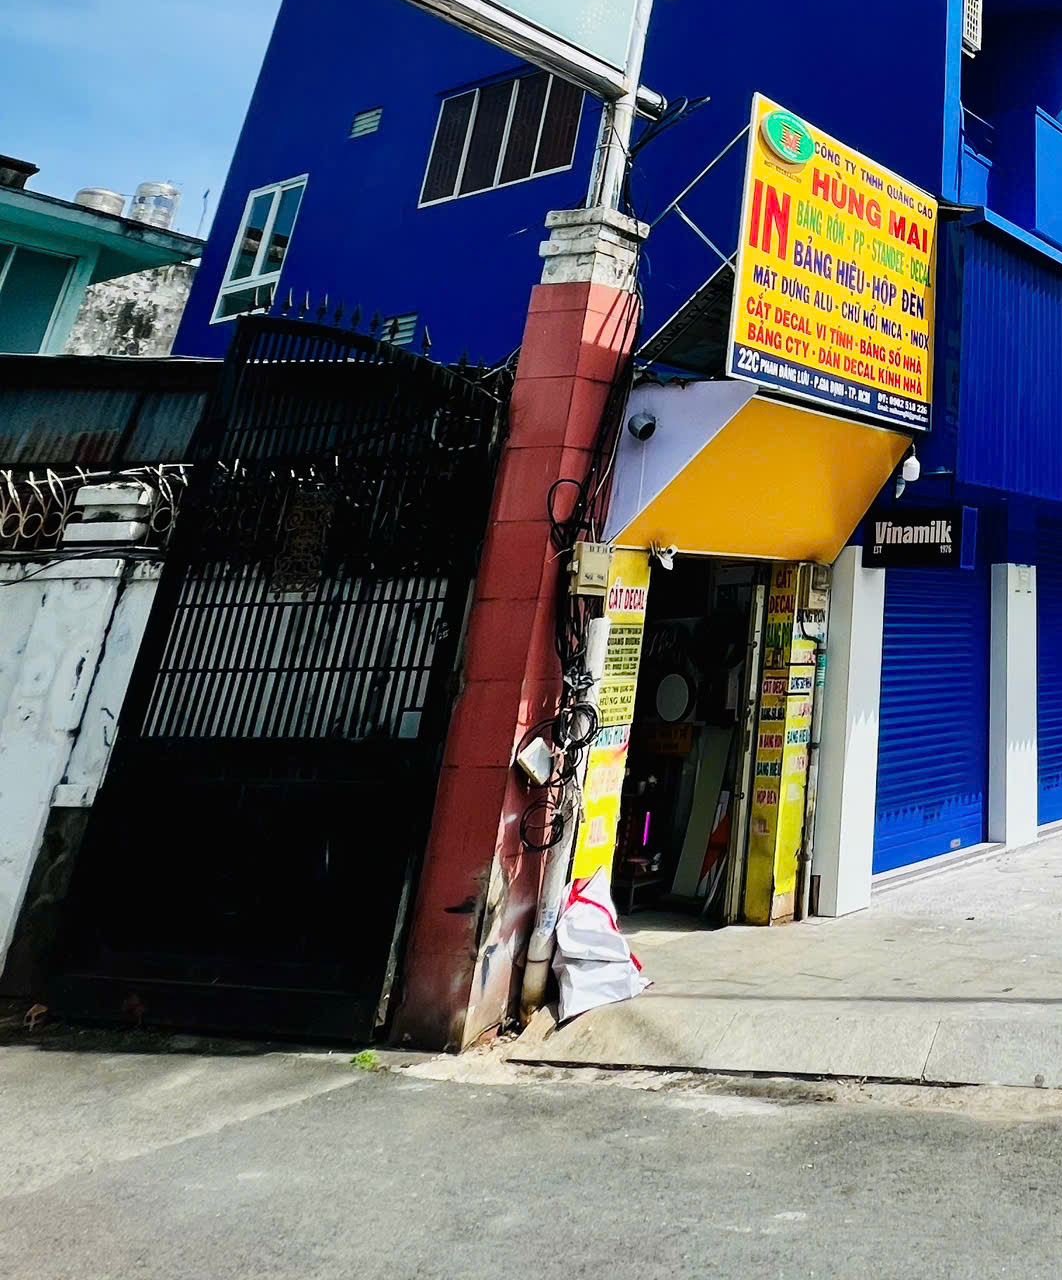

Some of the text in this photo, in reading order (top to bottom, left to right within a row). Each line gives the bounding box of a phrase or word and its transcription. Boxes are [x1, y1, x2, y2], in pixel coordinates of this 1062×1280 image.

[812, 168, 881, 229] HÙNG
[889, 209, 928, 254] MAI
[814, 142, 841, 166] CÔNG
[845, 160, 857, 175] TY
[861, 168, 883, 191] TNHH
[917, 202, 932, 219] CÁO
[748, 178, 791, 261] IN
[853, 228, 865, 255] PP
[872, 238, 904, 275] STANDEE
[911, 256, 931, 288] DECAL
[753, 264, 929, 352] MẶT DỰNG ALU CHỮ NỔI MICA INOX
[794, 235, 924, 320] BẢNG HIỆU HỘP ĐÈN
[737, 347, 760, 373] 22C
[760, 358, 779, 377] PHAN
[746, 292, 922, 375] CẮT DECAL VI TÍNH BẢNG SỐ NHÀ
[748, 320, 922, 397] BẢNG CTY DÁN DECAL KÍNH NHÀ
[873, 545, 882, 554] EST
[875, 520, 952, 544] Vinamilk
[624, 588, 644, 610] DECAL
[769, 595, 794, 614] DECAL
